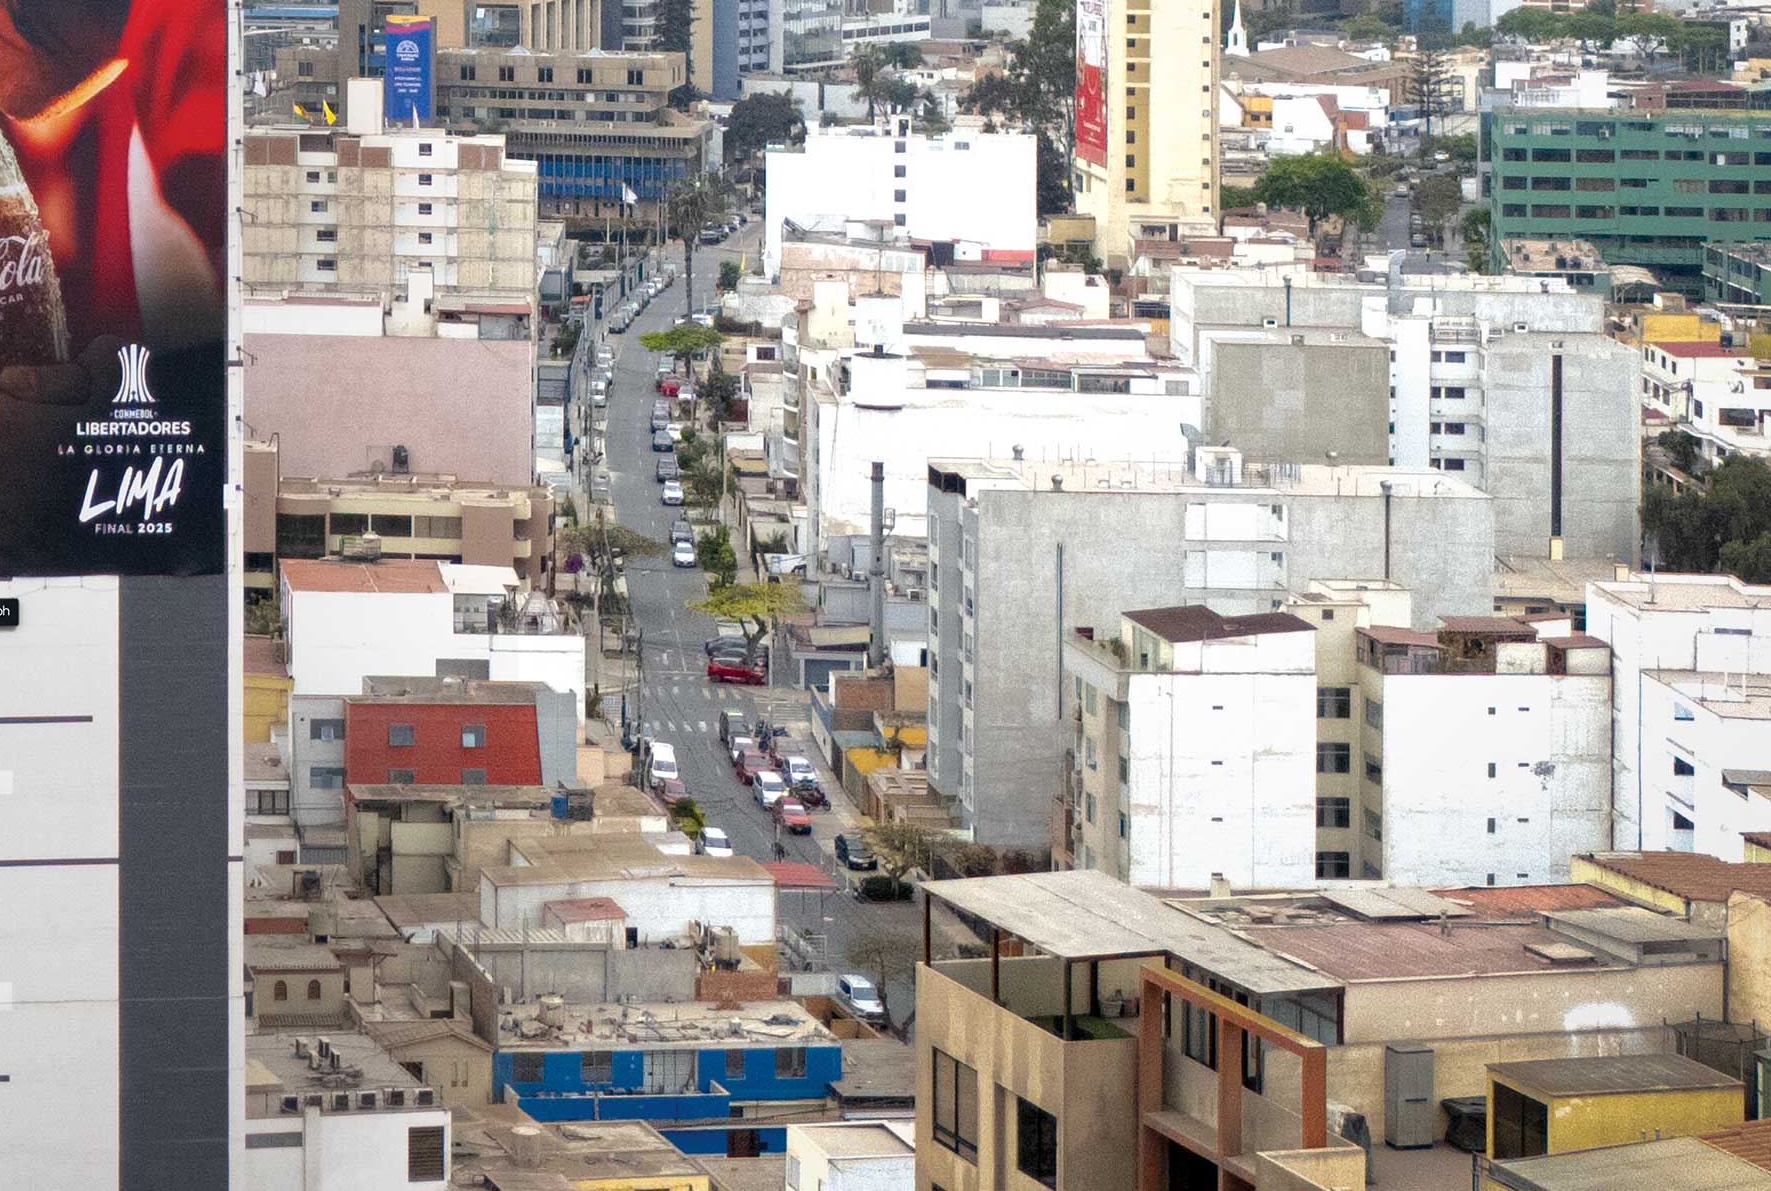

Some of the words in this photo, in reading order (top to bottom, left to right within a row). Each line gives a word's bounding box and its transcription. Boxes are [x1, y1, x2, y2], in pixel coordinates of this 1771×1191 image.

[114, 409, 154, 419] CONMEBOL
[76, 421, 191, 436] LIBERTADORES
[57, 444, 75, 456] LA
[84, 444, 141, 455] GLORIA
[150, 443, 205, 455] ETERNA
[78, 455, 185, 523] LIMA
[95, 523, 133, 535] FINAL
[137, 522, 173, 534] 2025
